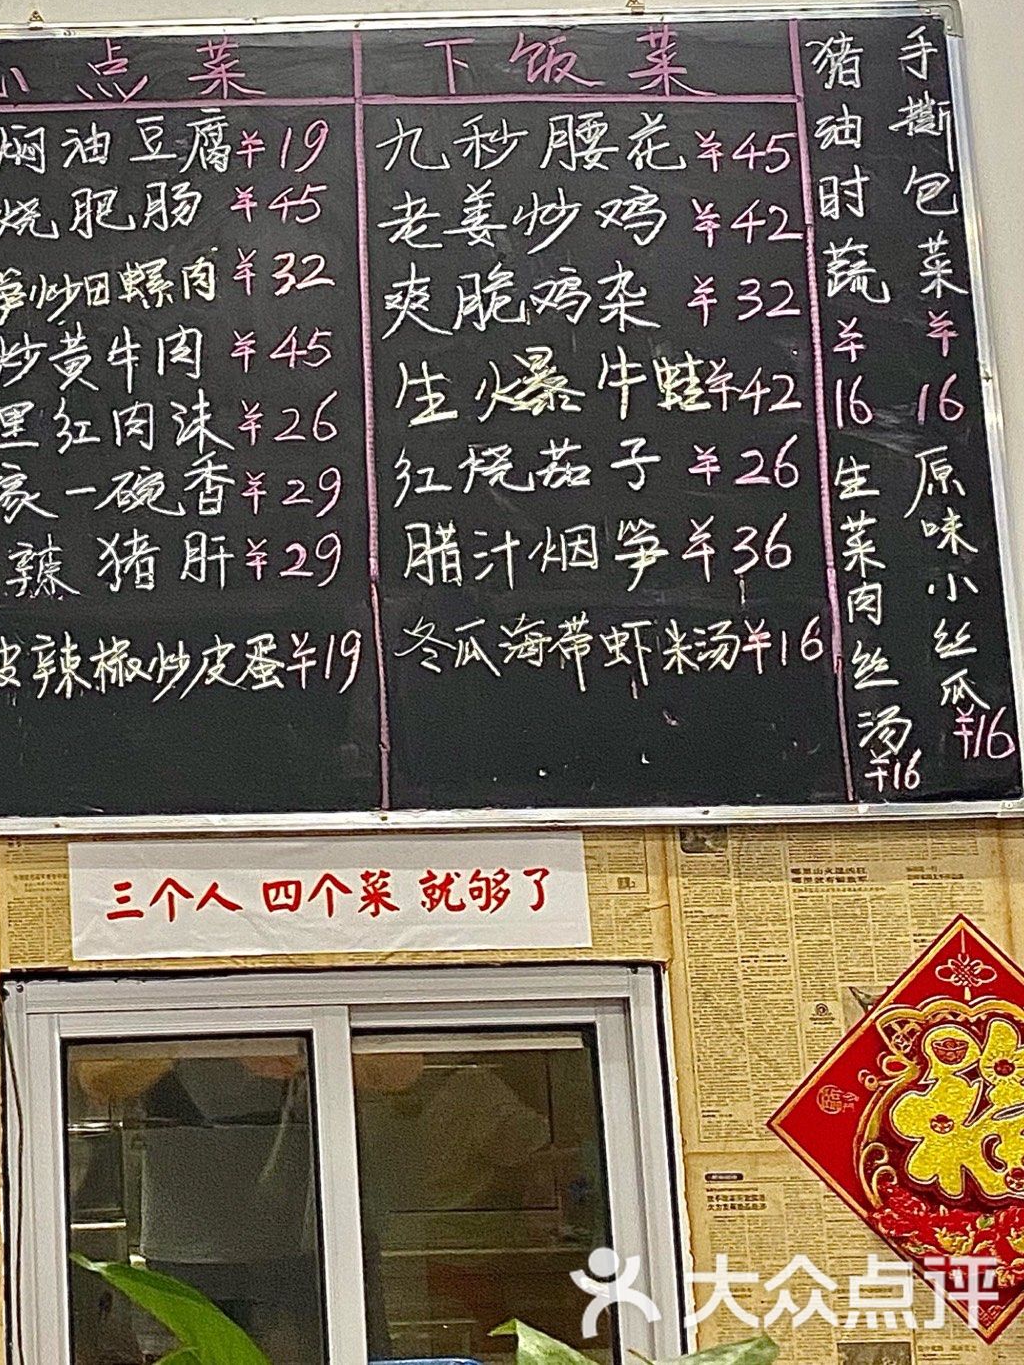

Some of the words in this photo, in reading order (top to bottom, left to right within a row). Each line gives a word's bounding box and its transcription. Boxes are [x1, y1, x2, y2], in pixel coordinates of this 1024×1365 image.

[424, 22, 718, 96] 下饭菜
[377, 111, 687, 172] 九秒腰花
[805, 33, 890, 305] 猪油时蔬
[889, 25, 969, 297] 手撕包菜
[377, 178, 667, 255] 老姜炒鸡
[381, 260, 662, 340] 爽脆鸡杂
[393, 435, 662, 508] 红烧茄子
[402, 518, 670, 592] 腊汁烟笋
[902, 444, 991, 711] 原味小丝瓜
[834, 455, 913, 756] 生菜肉丝汤
[393, 617, 743, 692] 冬瓜海带虾米汤
[105, 876, 244, 923] 三个人
[263, 870, 400, 918] 四个菜
[420, 866, 551, 914] 就够了
